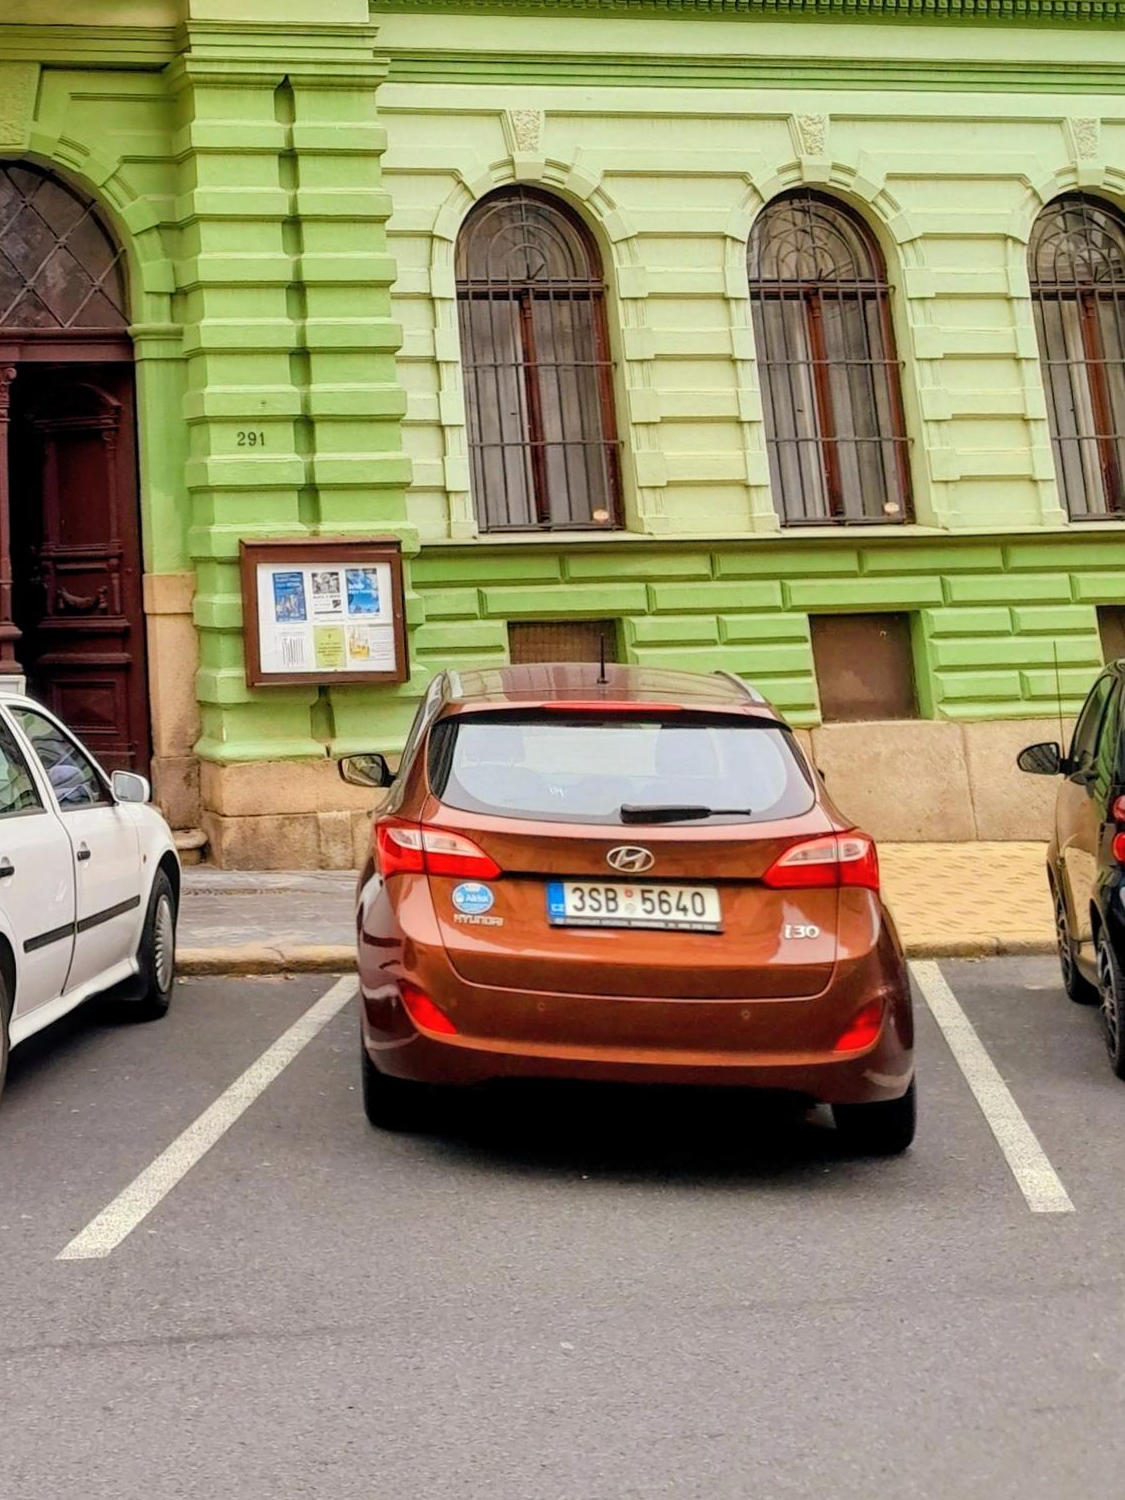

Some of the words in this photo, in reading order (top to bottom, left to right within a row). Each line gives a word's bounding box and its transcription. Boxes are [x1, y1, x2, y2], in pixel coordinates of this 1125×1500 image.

[237, 431, 265, 446] 291
[572, 887, 619, 913] 3SB
[640, 889, 706, 917] 5640
[454, 914, 504, 926] HYUNDAI
[785, 924, 820, 939] i30
